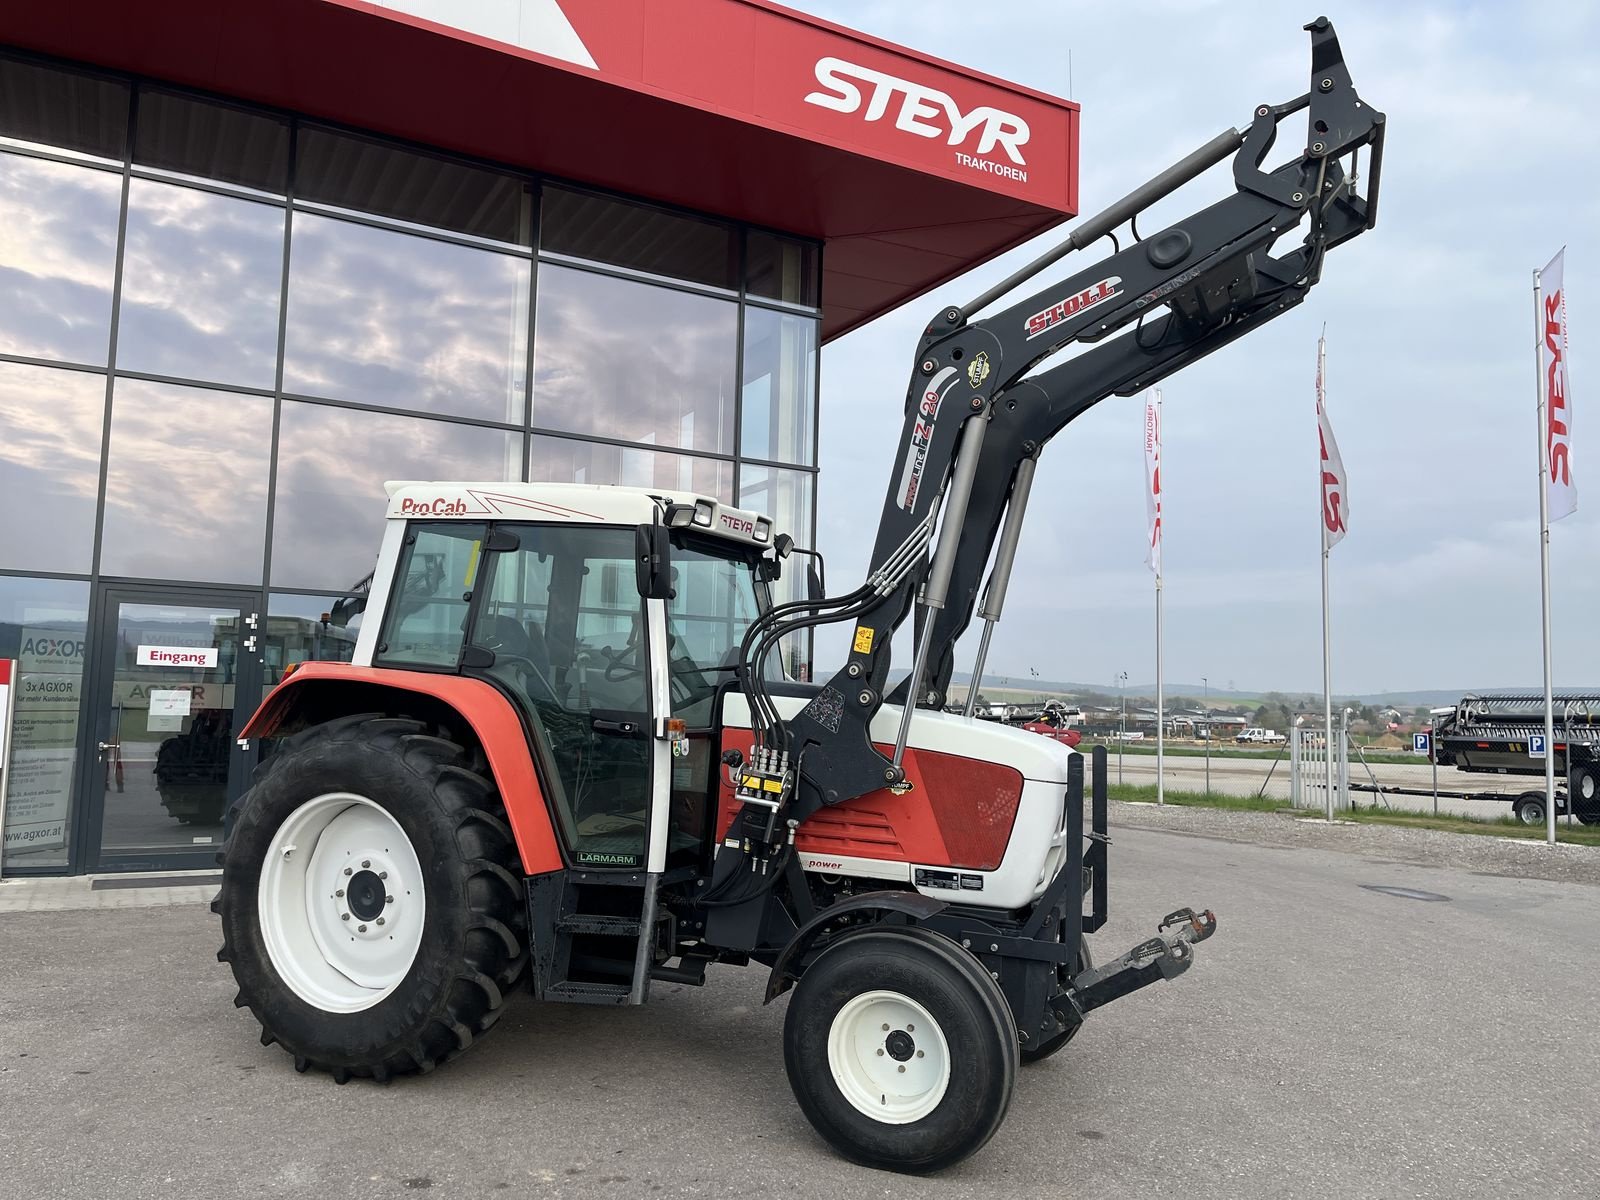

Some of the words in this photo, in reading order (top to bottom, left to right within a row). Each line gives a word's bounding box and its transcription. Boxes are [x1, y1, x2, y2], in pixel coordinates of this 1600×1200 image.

[804, 56, 1030, 166] STEYR
[955, 152, 1027, 183] TRAKTOREN
[1029, 281, 1115, 335] STOLL
[973, 356, 984, 384] STUMPF
[1545, 289, 1569, 487] STEYR
[922, 391, 939, 415] 20
[22, 638, 85, 658] AGXOR
[150, 650, 206, 665] Eingang
[26, 682, 37, 692] 3x
[39, 682, 73, 693] AGXOR
[1417, 735, 1425, 748] P
[1533, 738, 1541, 750] P
[5, 826, 61, 841] ww.agxor.at
[580, 853, 633, 863] LÄRMARM
[808, 860, 843, 869] power
